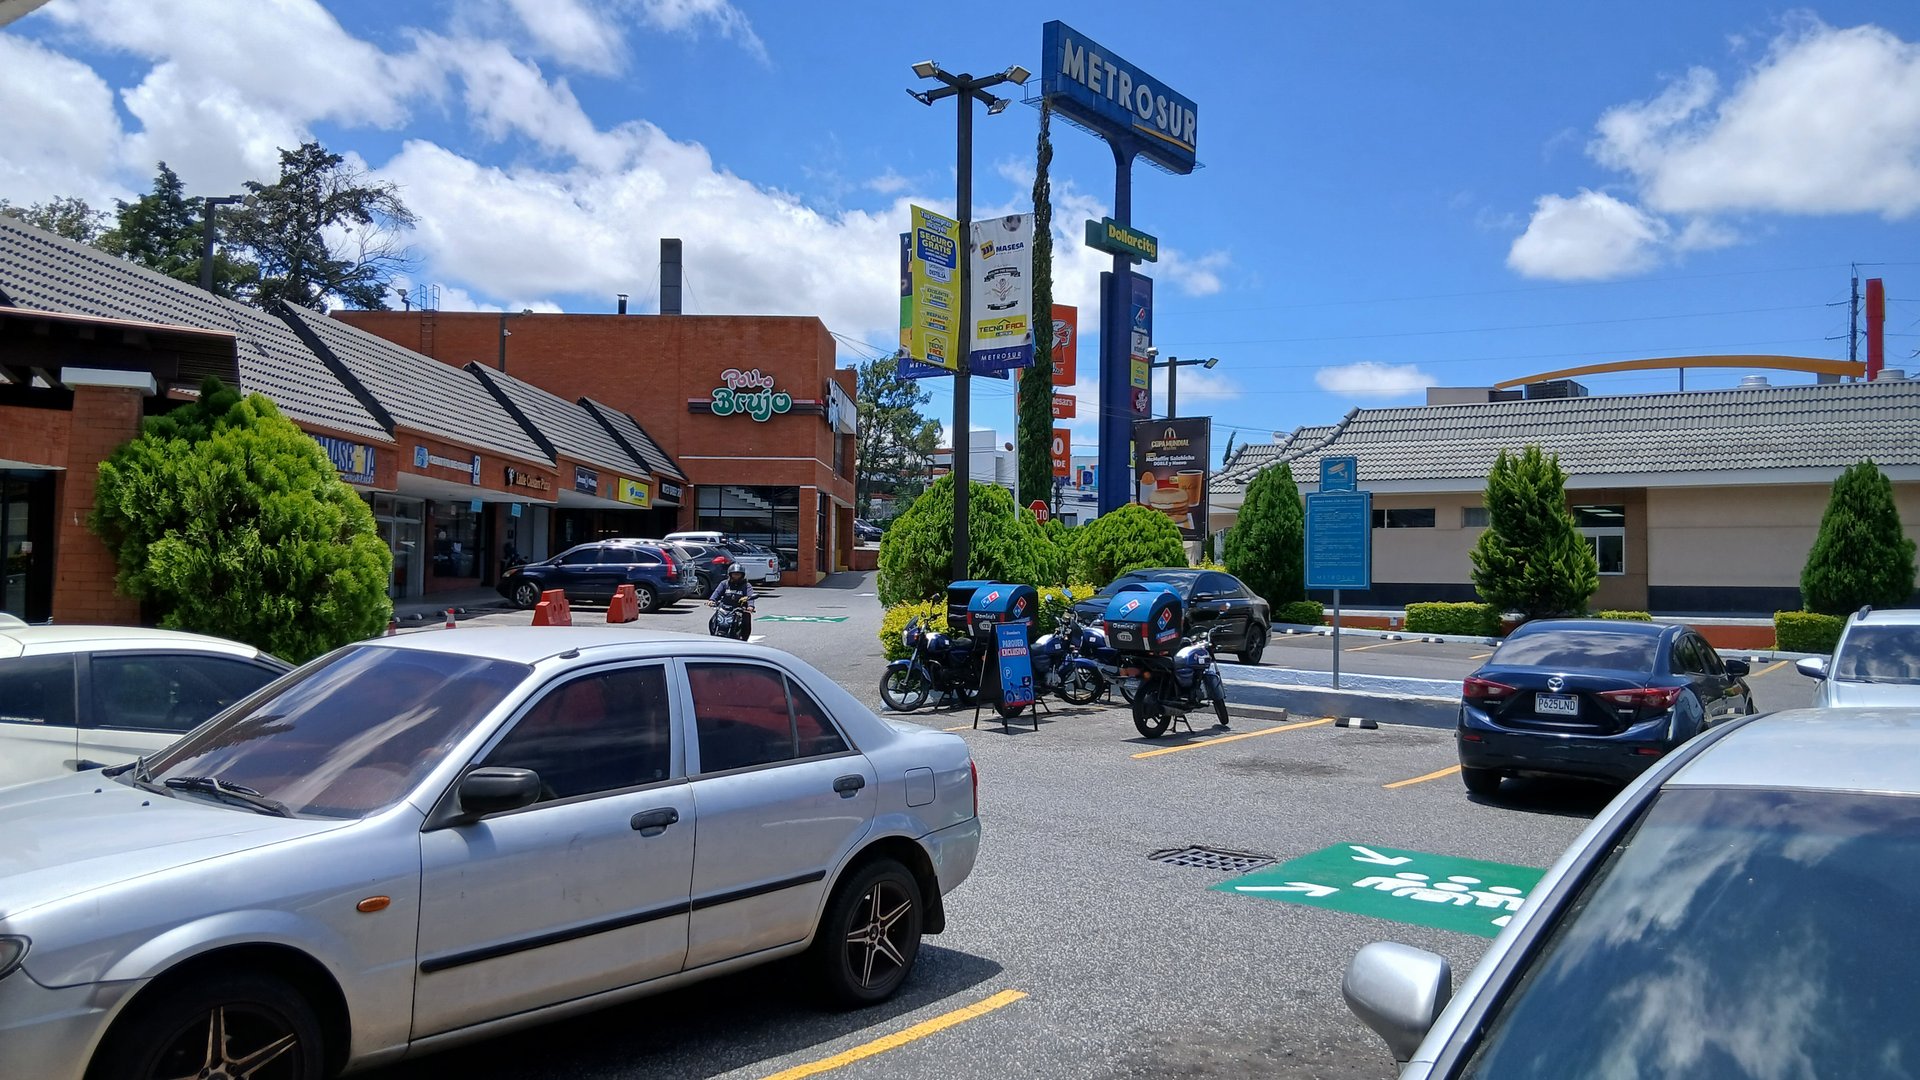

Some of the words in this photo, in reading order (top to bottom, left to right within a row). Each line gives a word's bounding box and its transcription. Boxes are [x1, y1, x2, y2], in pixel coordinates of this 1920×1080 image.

[1062, 38, 1196, 146] METROSUR
[920, 231, 954, 248] SEGURO
[1108, 224, 1156, 258] Dollarcity
[922, 239, 952, 255] GRATIS
[995, 242, 1025, 253] MASESA
[979, 325, 1004, 333] TECNO
[981, 351, 1022, 361] METROSUR
[721, 368, 774, 390] Pollo
[711, 387, 792, 422] Brujo
[1034, 509, 1048, 520] LTO
[1002, 639, 1024, 648] PARQUEO
[1001, 647, 1027, 657] EXCLUSIVO
[1538, 698, 1576, 711] P625LND
